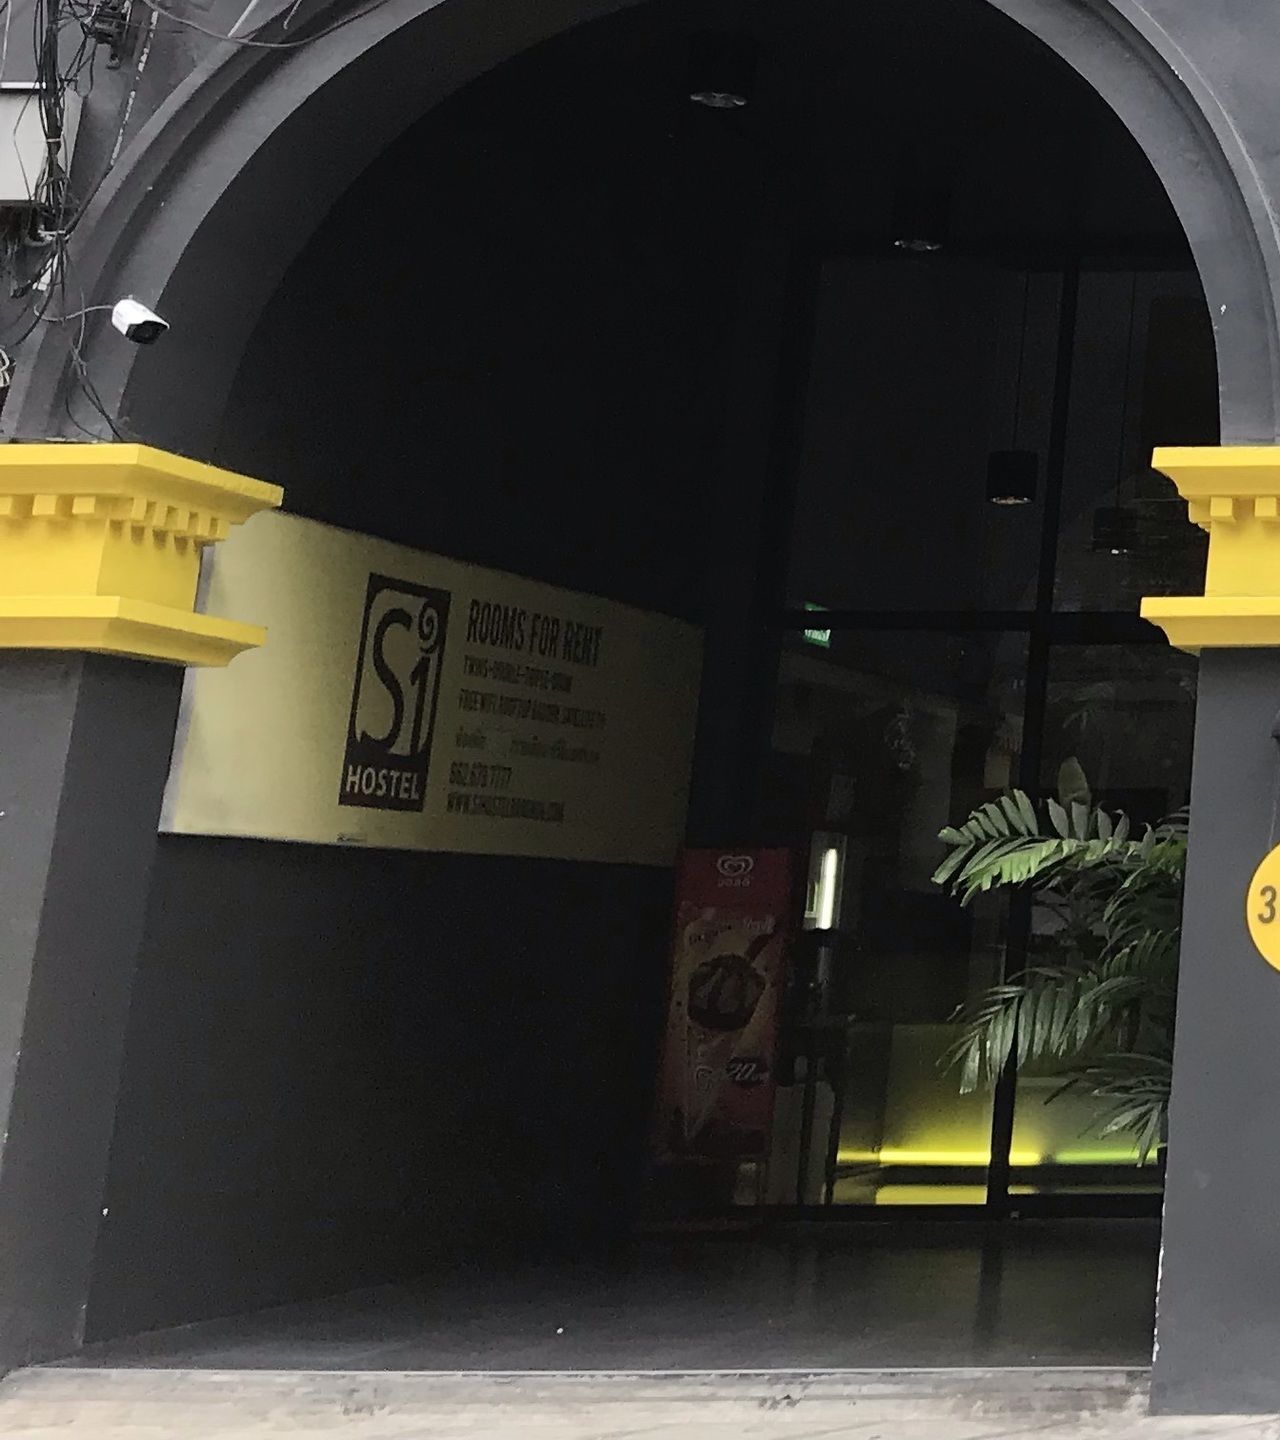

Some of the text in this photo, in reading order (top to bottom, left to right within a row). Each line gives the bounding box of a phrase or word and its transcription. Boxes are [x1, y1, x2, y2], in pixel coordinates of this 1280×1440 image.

[466, 599, 604, 667] ROOMS FOR RENT
[345, 764, 420, 800] HOSTEL
